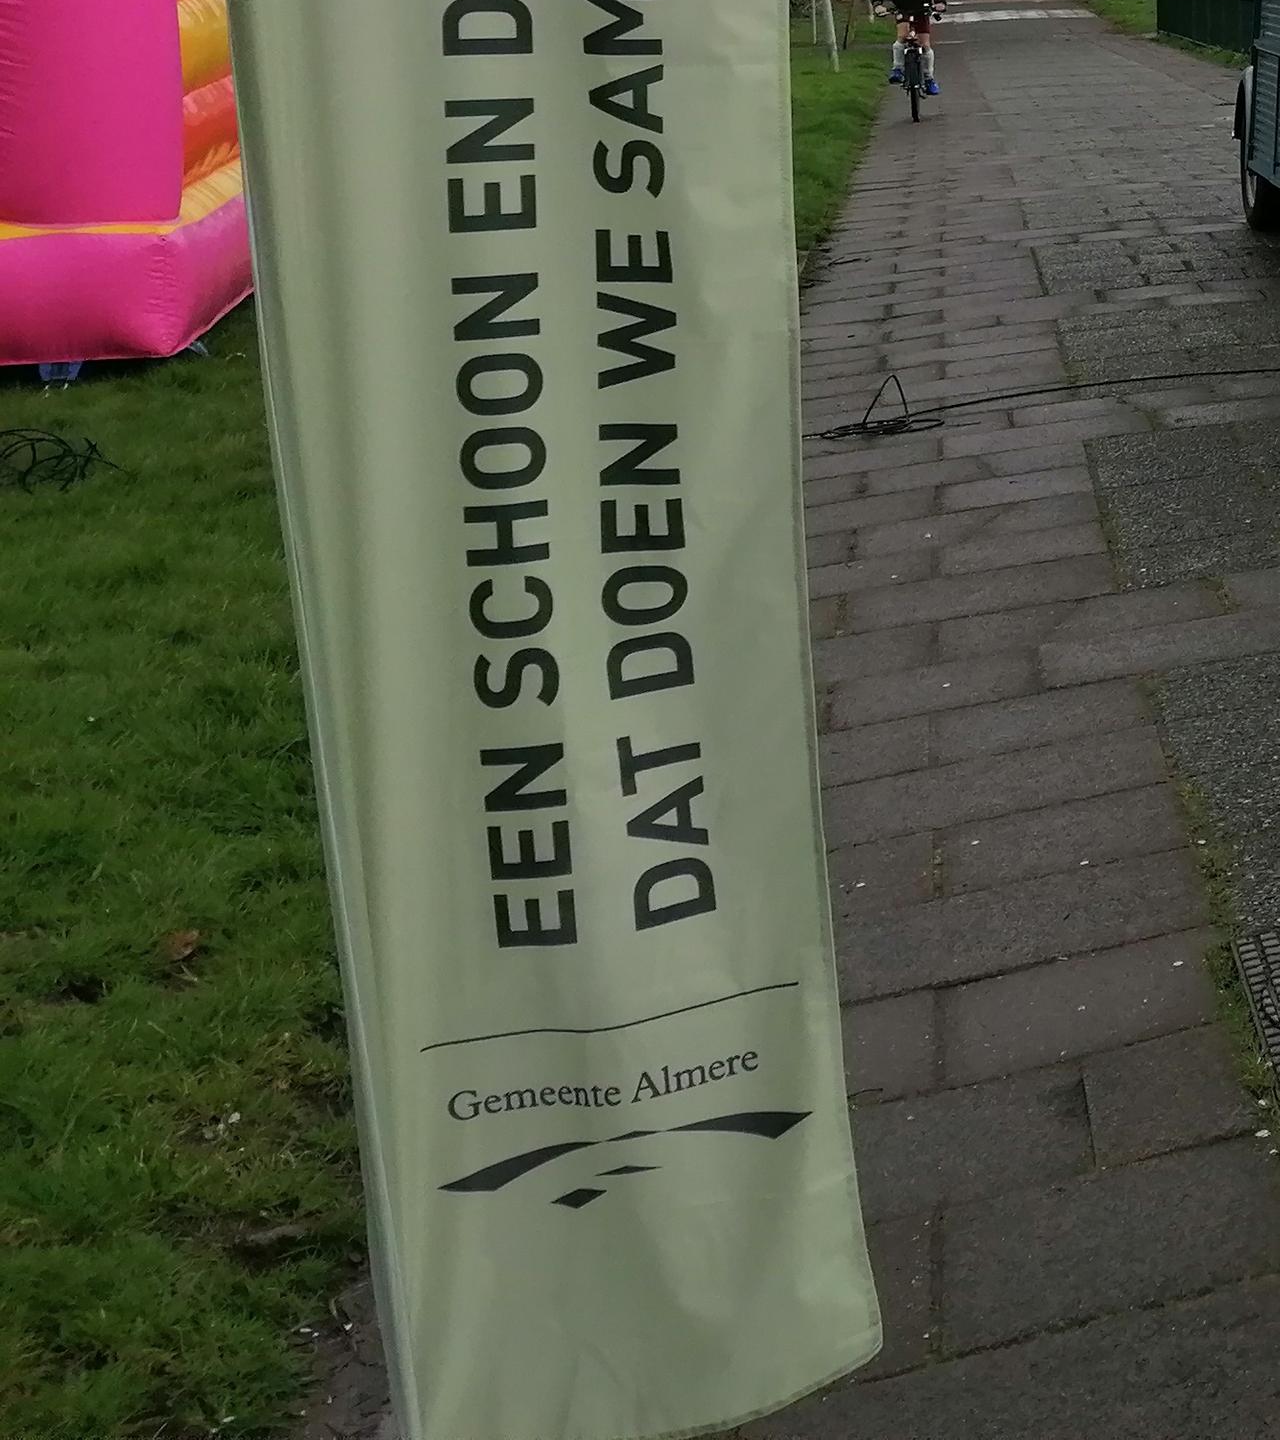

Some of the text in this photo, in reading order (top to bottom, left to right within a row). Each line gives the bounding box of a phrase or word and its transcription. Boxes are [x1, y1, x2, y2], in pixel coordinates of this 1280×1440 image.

[444, 97, 538, 234] EN
[594, 228, 678, 390] WE
[450, 271, 560, 709] SCHOON
[598, 422, 695, 701] DOEN
[480, 742, 578, 949] EEN
[616, 735, 718, 932] DAT
[447, 1046, 760, 1122] Gemeente Almere
